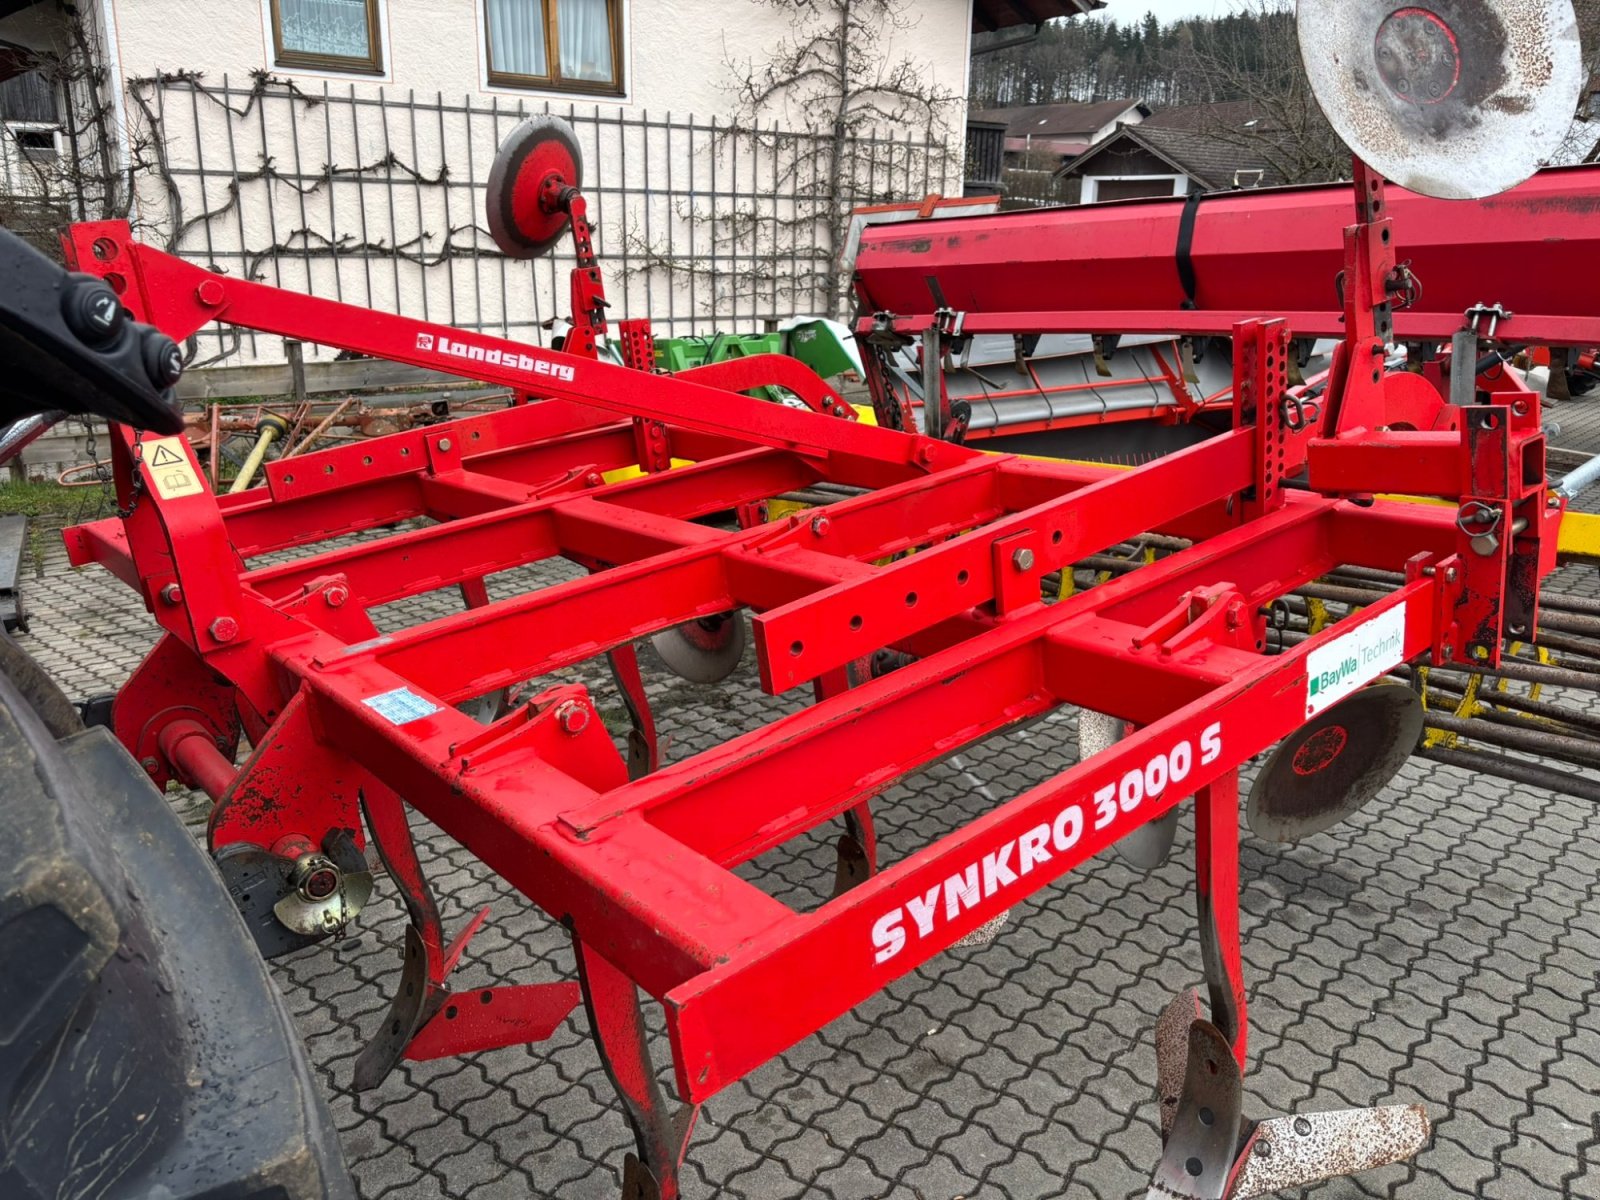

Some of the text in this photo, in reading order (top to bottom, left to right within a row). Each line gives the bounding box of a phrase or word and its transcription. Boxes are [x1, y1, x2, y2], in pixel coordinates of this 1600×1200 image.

[438, 337, 575, 381] Landsberg
[1320, 628, 1401, 690] BayWa Technik
[872, 721, 1222, 963] SYNKRO 3000 S
